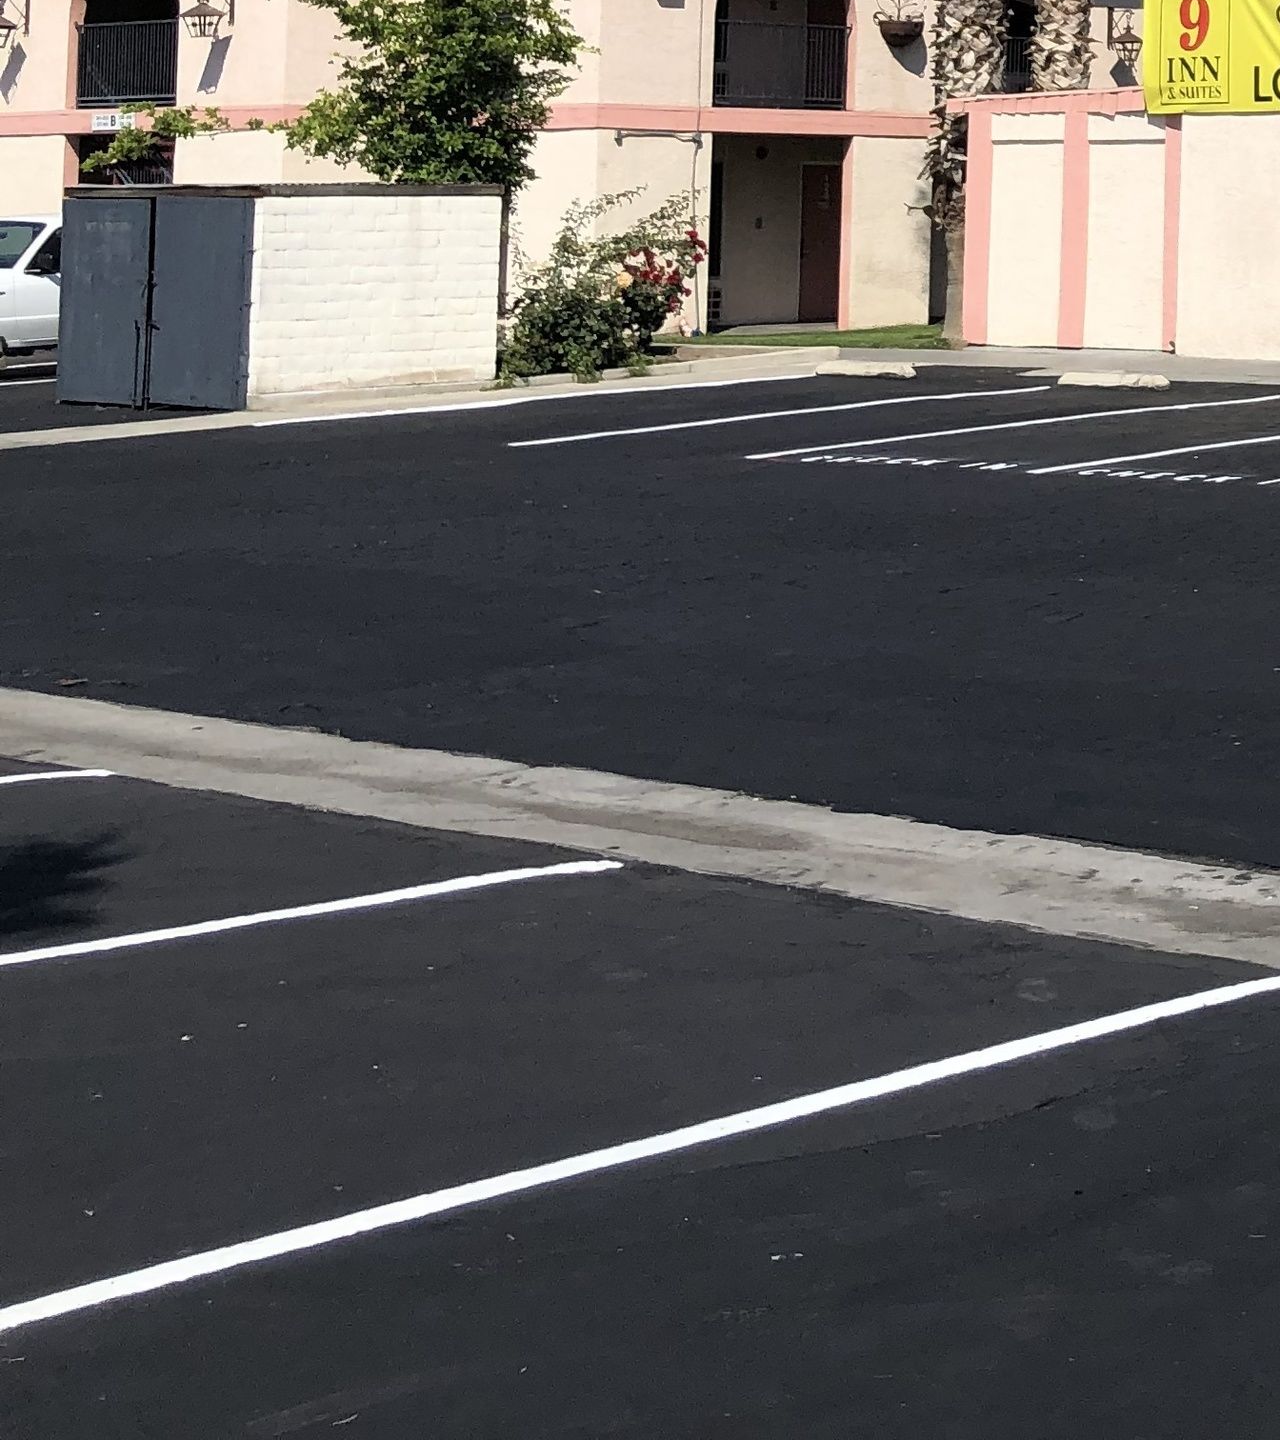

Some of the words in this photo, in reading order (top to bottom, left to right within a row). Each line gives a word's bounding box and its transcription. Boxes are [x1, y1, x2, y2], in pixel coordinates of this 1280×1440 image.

[1167, 56, 1221, 83] INN
[1167, 86, 1177, 100] &
[1179, 85, 1222, 99] SUITES
[1077, 468, 1242, 483] CHECK
